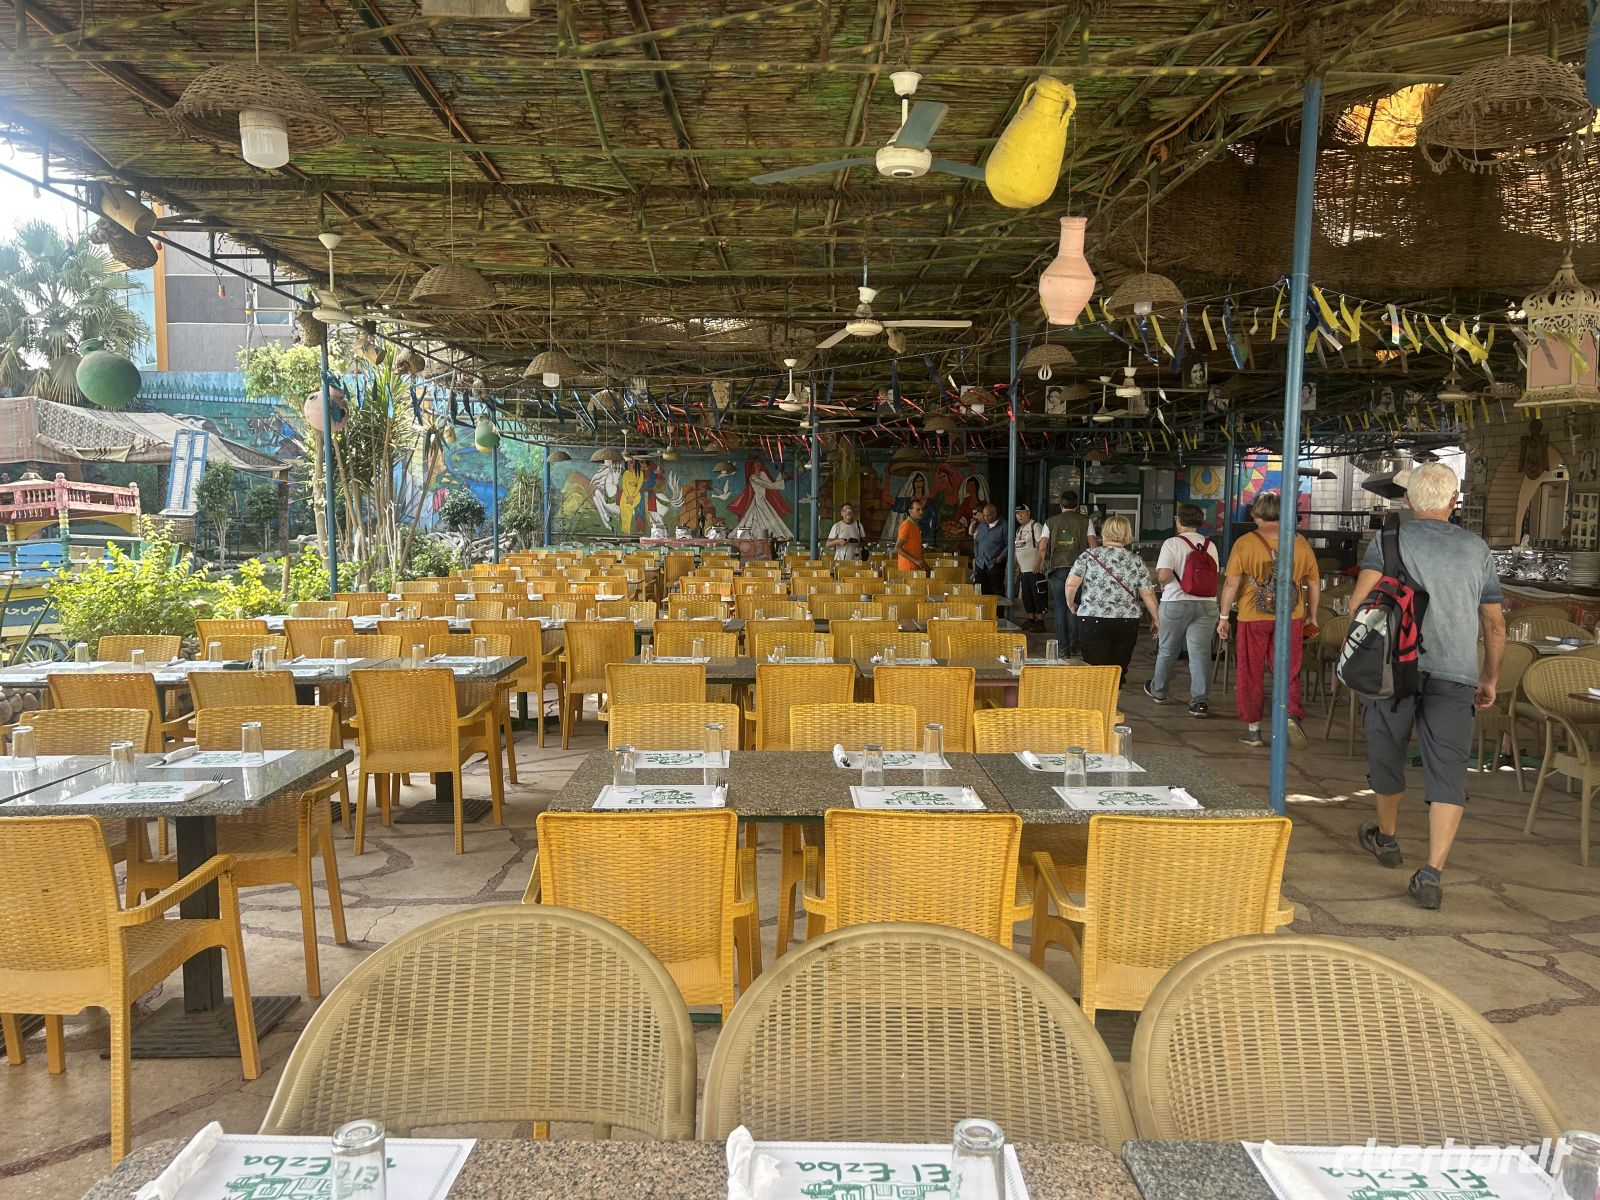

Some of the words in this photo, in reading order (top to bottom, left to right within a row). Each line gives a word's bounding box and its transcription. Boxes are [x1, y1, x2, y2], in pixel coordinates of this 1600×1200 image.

[243, 1154, 333, 1176] Ezba
[795, 1161, 897, 1183] Ezba
[911, 1163, 952, 1183] El
[1440, 1168, 1488, 1189] El
